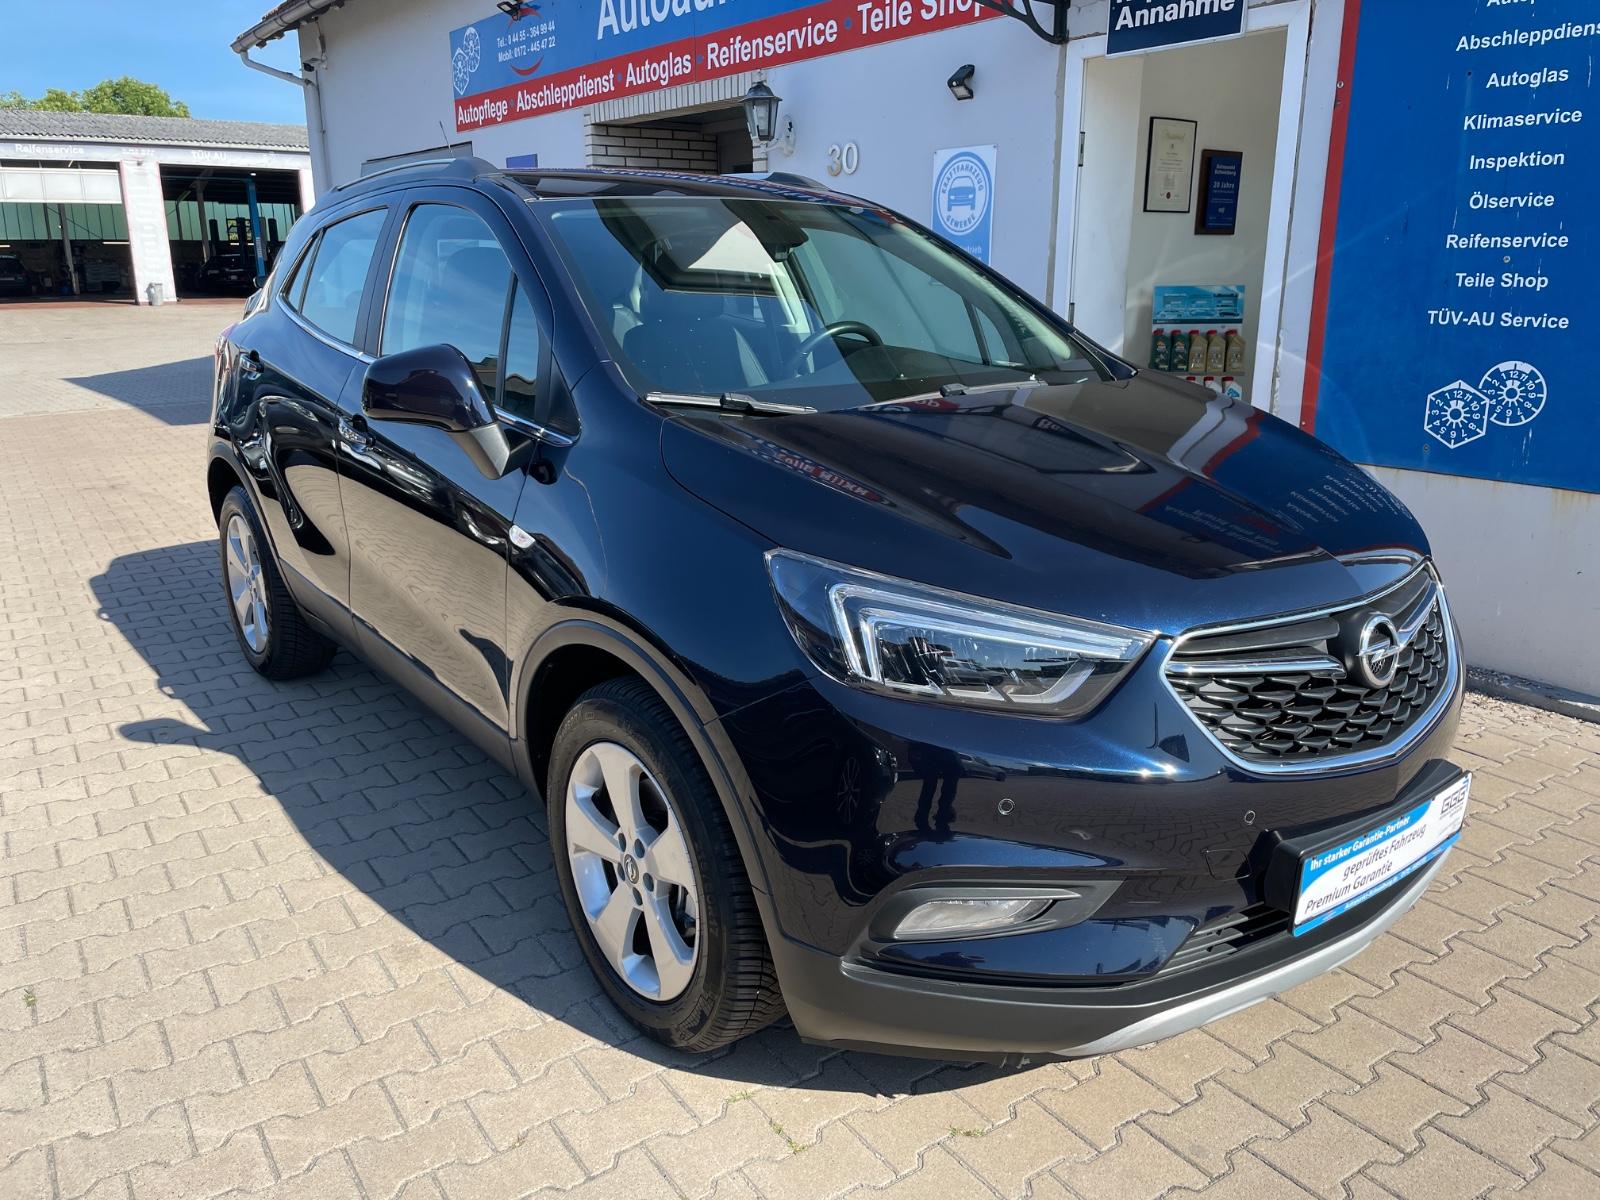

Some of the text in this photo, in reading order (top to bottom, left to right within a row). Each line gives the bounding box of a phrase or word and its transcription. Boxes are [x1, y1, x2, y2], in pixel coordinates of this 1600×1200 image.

[1115, 0, 1235, 31] Annahme
[512, 32, 519, 43] 44
[519, 30, 526, 41] 55
[530, 26, 540, 39] 364
[548, 20, 555, 32] 44
[514, 45, 527, 58] 0172
[530, 41, 541, 53] 445
[541, 38, 548, 50] 47
[548, 36, 556, 48] 22
[457, 98, 508, 125] Autopflege
[516, 68, 615, 112] Abschleppdienst
[625, 52, 692, 88] Autoglas
[707, 18, 837, 70] Reifenservice
[857, 0, 912, 34] Teile
[1486, 68, 1569, 89] Autoglas
[1463, 108, 1583, 130] Klimaservice
[15, 144, 84, 154] Reifenservice
[827, 142, 858, 176] 30
[1469, 151, 1565, 171] Inspektion
[942, 163, 985, 194] KRAFTFAHRZEUG
[1469, 192, 1555, 209] Ölservice
[946, 214, 976, 229] GEWERBE
[1446, 233, 1569, 249] Reifenservice
[1455, 273, 1549, 291] Teile Shop
[1427, 308, 1570, 329] TÜV-AU Service
[1453, 391, 1462, 399] 12
[1464, 393, 1472, 401] 11
[1492, 379, 1500, 387] 2
[1496, 405, 1503, 413] 5
[1506, 409, 1512, 417] 6
[1517, 407, 1522, 415] 7
[1526, 381, 1535, 390] 10
[1470, 401, 1479, 411] 10
[1461, 429, 1467, 437] 7
[1310, 858, 1322, 871] Ihr
[1323, 848, 1351, 866] starker
[1352, 816, 1411, 851] Garantie-Partner
[1343, 844, 1389, 881] geprüftes
[1388, 823, 1427, 855] Fahrzeug
[1305, 883, 1351, 914] Premium
[1353, 860, 1393, 890] Garantie
